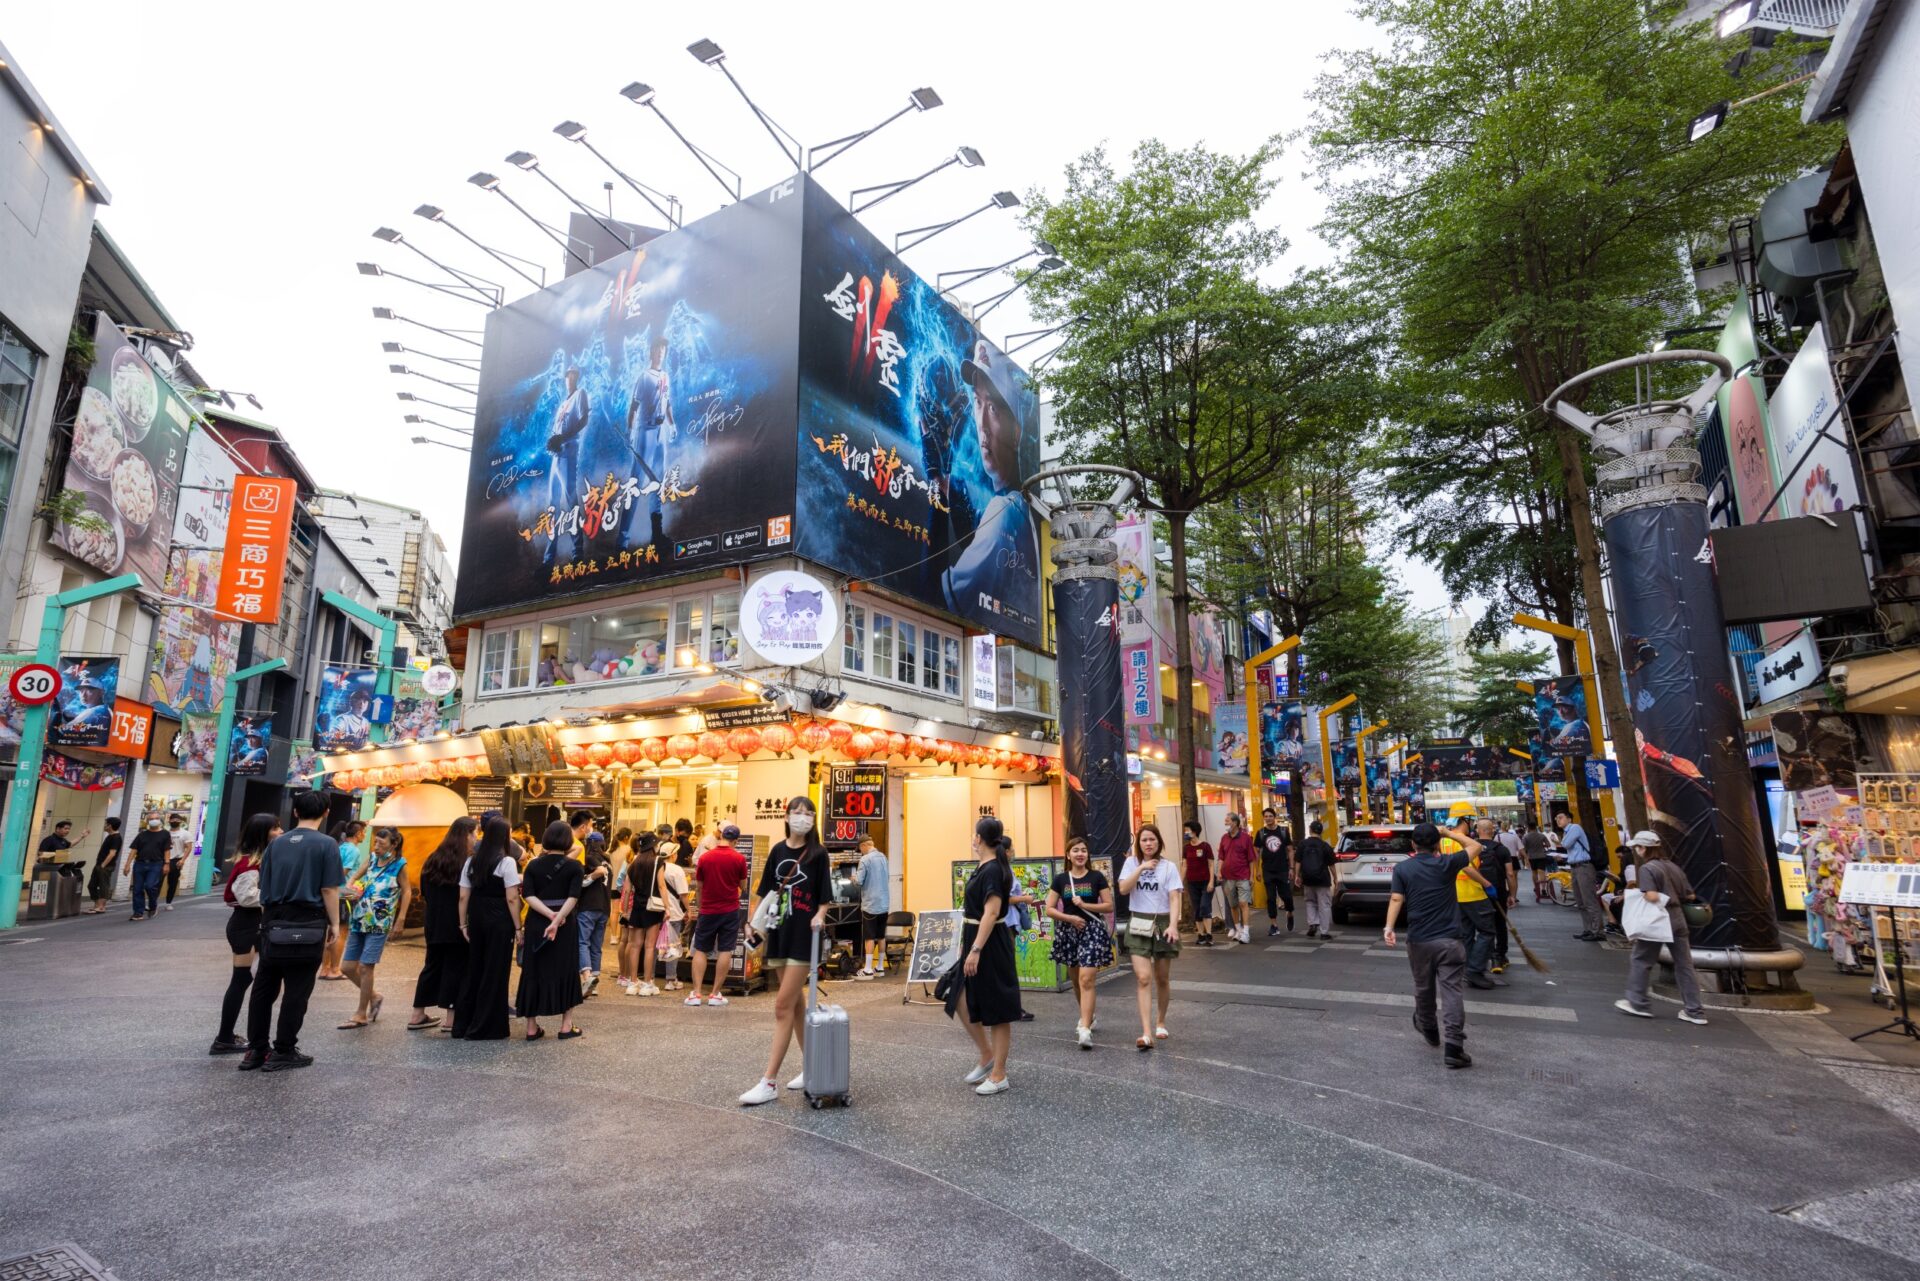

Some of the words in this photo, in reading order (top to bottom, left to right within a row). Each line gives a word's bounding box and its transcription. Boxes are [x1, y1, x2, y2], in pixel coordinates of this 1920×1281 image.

[687, 541, 703, 550] Google
[703, 539, 713, 547] Play
[734, 533, 744, 541] App
[745, 529, 758, 538] Store
[232, 518, 273, 615] 三商巧福
[604, 543, 660, 571] 立即下載
[21, 676, 50, 693] 30
[1131, 649, 1150, 718] 請上2樓
[112, 711, 149, 745] 巧福
[20, 761, 31, 770] E
[15, 778, 30, 788] 19
[835, 769, 854, 785] 9H
[845, 791, 875, 816] 80
[836, 821, 857, 840] 80
[919, 953, 942, 973] 80
